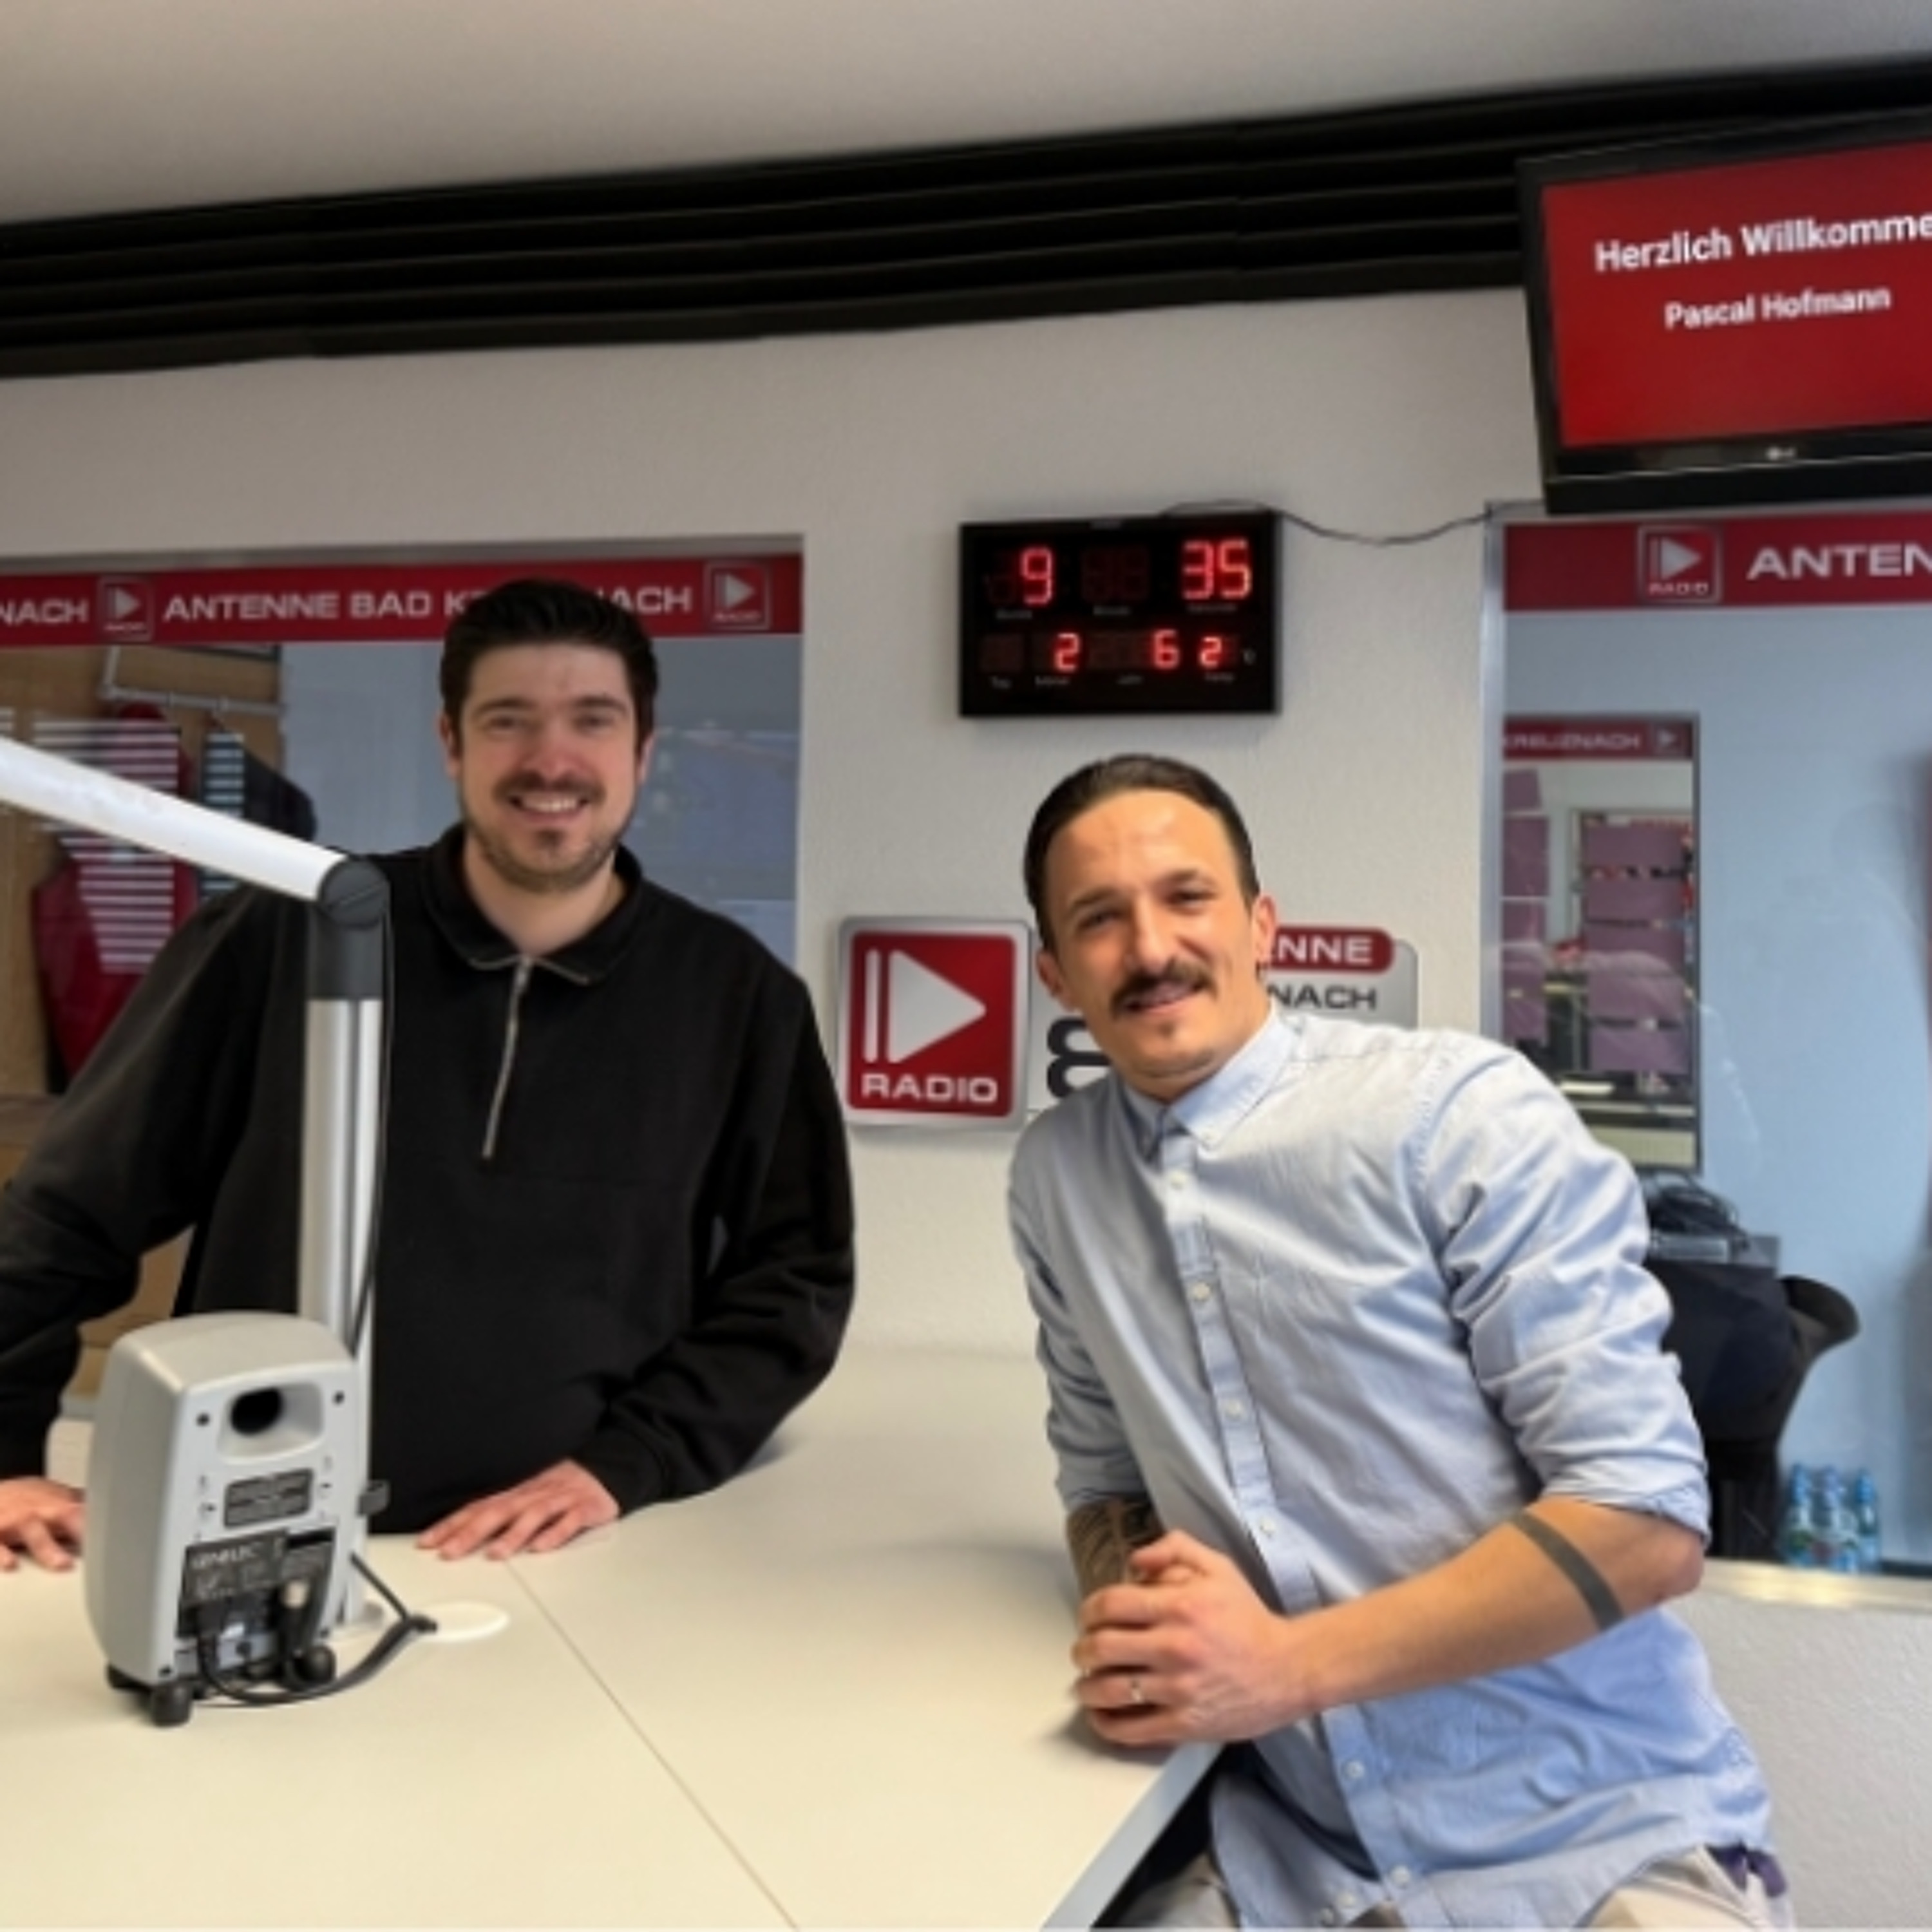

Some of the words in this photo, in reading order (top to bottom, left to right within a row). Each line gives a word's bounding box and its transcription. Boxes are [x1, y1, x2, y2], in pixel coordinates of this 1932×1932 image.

[1594, 227, 1733, 272] Herzlich
[1741, 214, 1932, 256] Willkomme
[1664, 294, 1756, 331] Pascal
[1761, 287, 1891, 320] Hofmann
[1020, 545, 1054, 605] 9
[1182, 537, 1252, 600] 35
[1746, 541, 1932, 580] ANTEN
[162, 592, 339, 623] ANTENNE
[349, 589, 432, 620] BAD
[860, 1074, 999, 1104] RADIO
